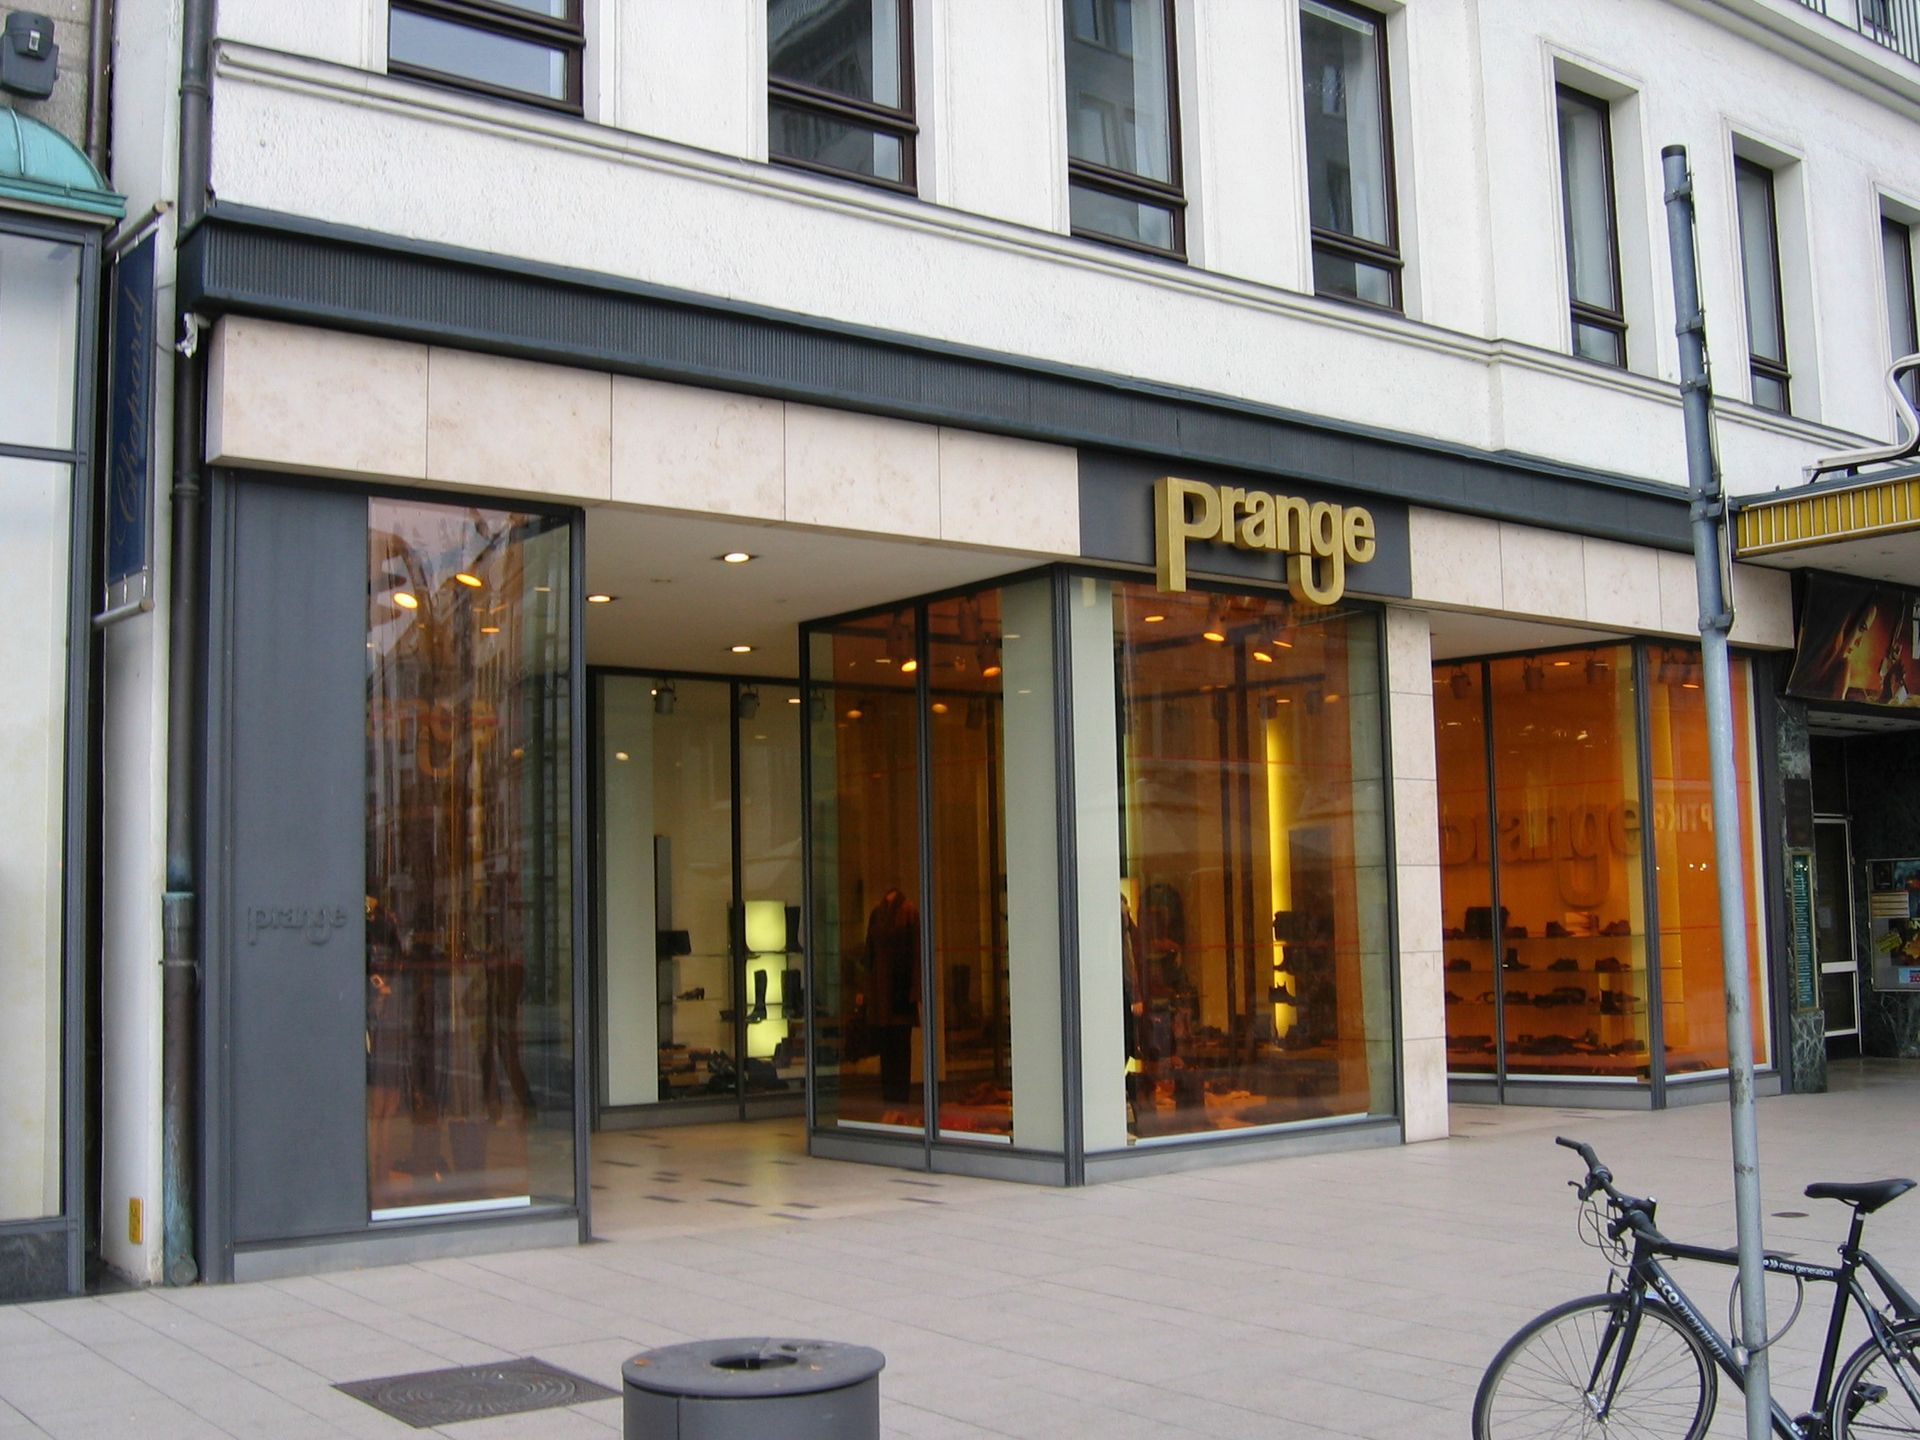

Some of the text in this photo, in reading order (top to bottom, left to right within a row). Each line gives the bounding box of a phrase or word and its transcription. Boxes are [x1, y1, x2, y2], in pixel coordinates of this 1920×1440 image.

[1153, 476, 1376, 606] prange
[247, 904, 348, 947] prange
[1779, 1262, 1796, 1271] new
[1795, 1265, 1835, 1277] generation
